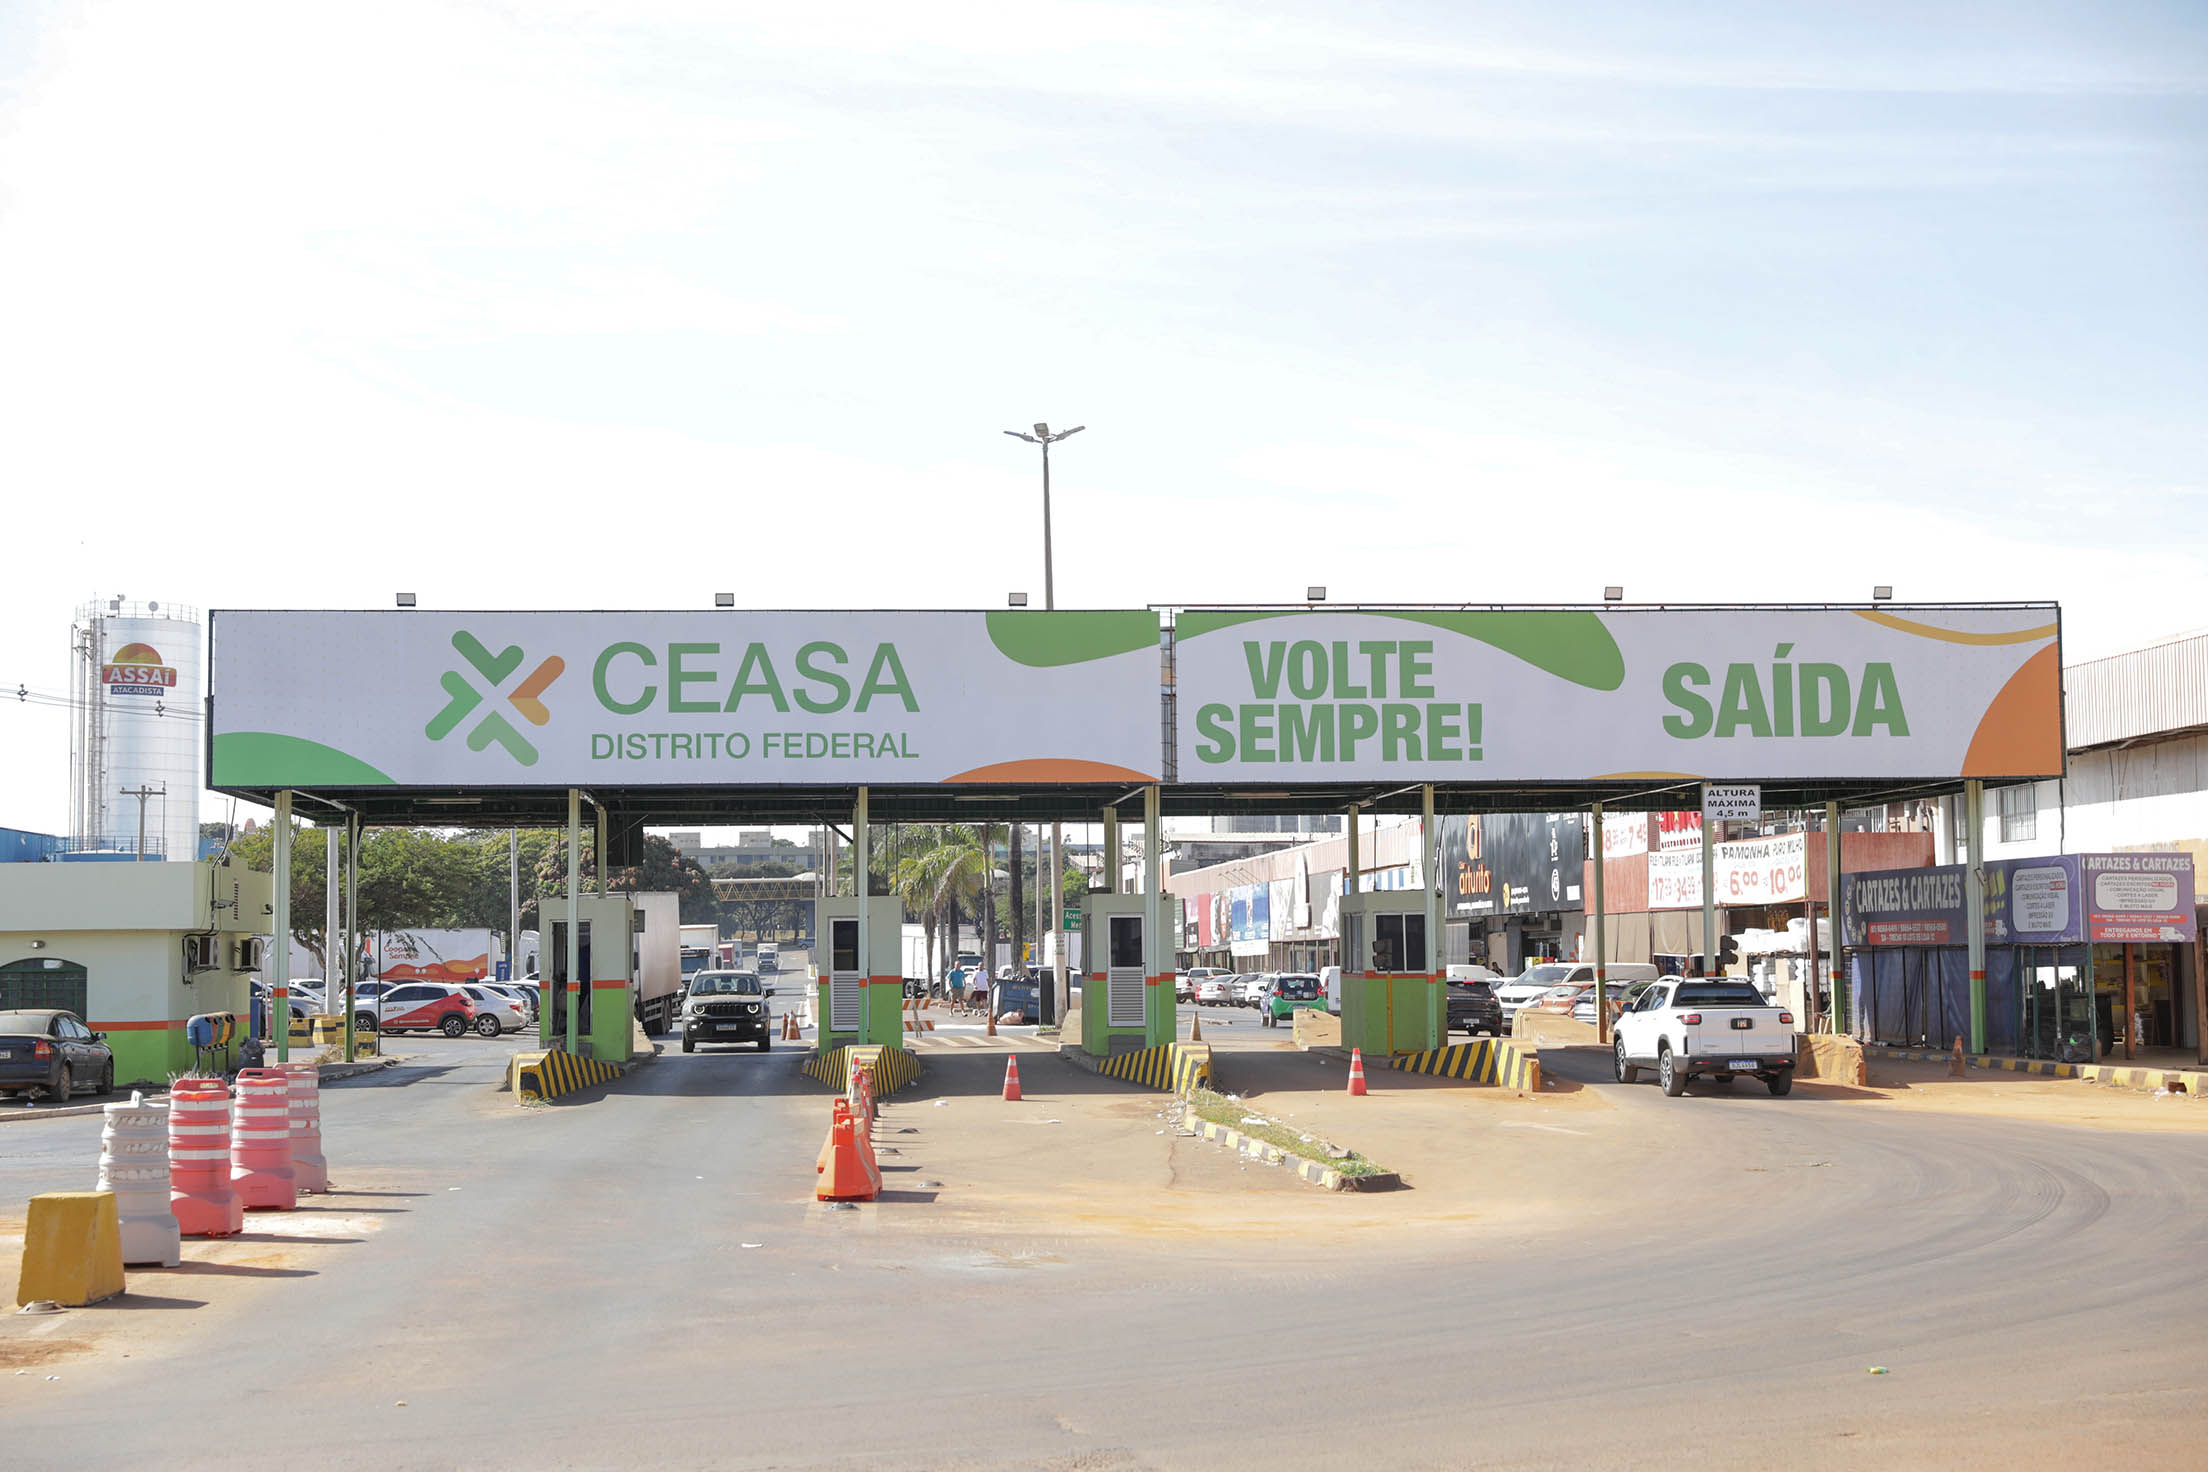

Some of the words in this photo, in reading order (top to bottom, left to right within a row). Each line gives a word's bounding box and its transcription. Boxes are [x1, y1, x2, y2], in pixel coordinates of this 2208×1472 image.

[592, 641, 921, 715] CEASA
[1242, 639, 1435, 701] VOLTE
[112, 686, 162, 695] ATACADISTA
[1662, 642, 1911, 740] SAÍDA
[1195, 703, 1483, 764] SEMPRE!
[591, 732, 751, 760] DISTRITO
[762, 732, 920, 759] FEDERAL
[1708, 789, 1756, 797] ALTURA
[1707, 798, 1756, 808] MÁXIMA
[1716, 809, 1735, 818] 4,5
[1721, 844, 1770, 860] PAMONHA
[2132, 857, 2140, 871] &
[2142, 857, 2191, 871] CARTAZES
[1856, 878, 1901, 913] CARTAZES
[1902, 878, 1910, 911] &
[1910, 874, 1961, 910] CARTAZES
[1064, 911, 1080, 919] Aces
